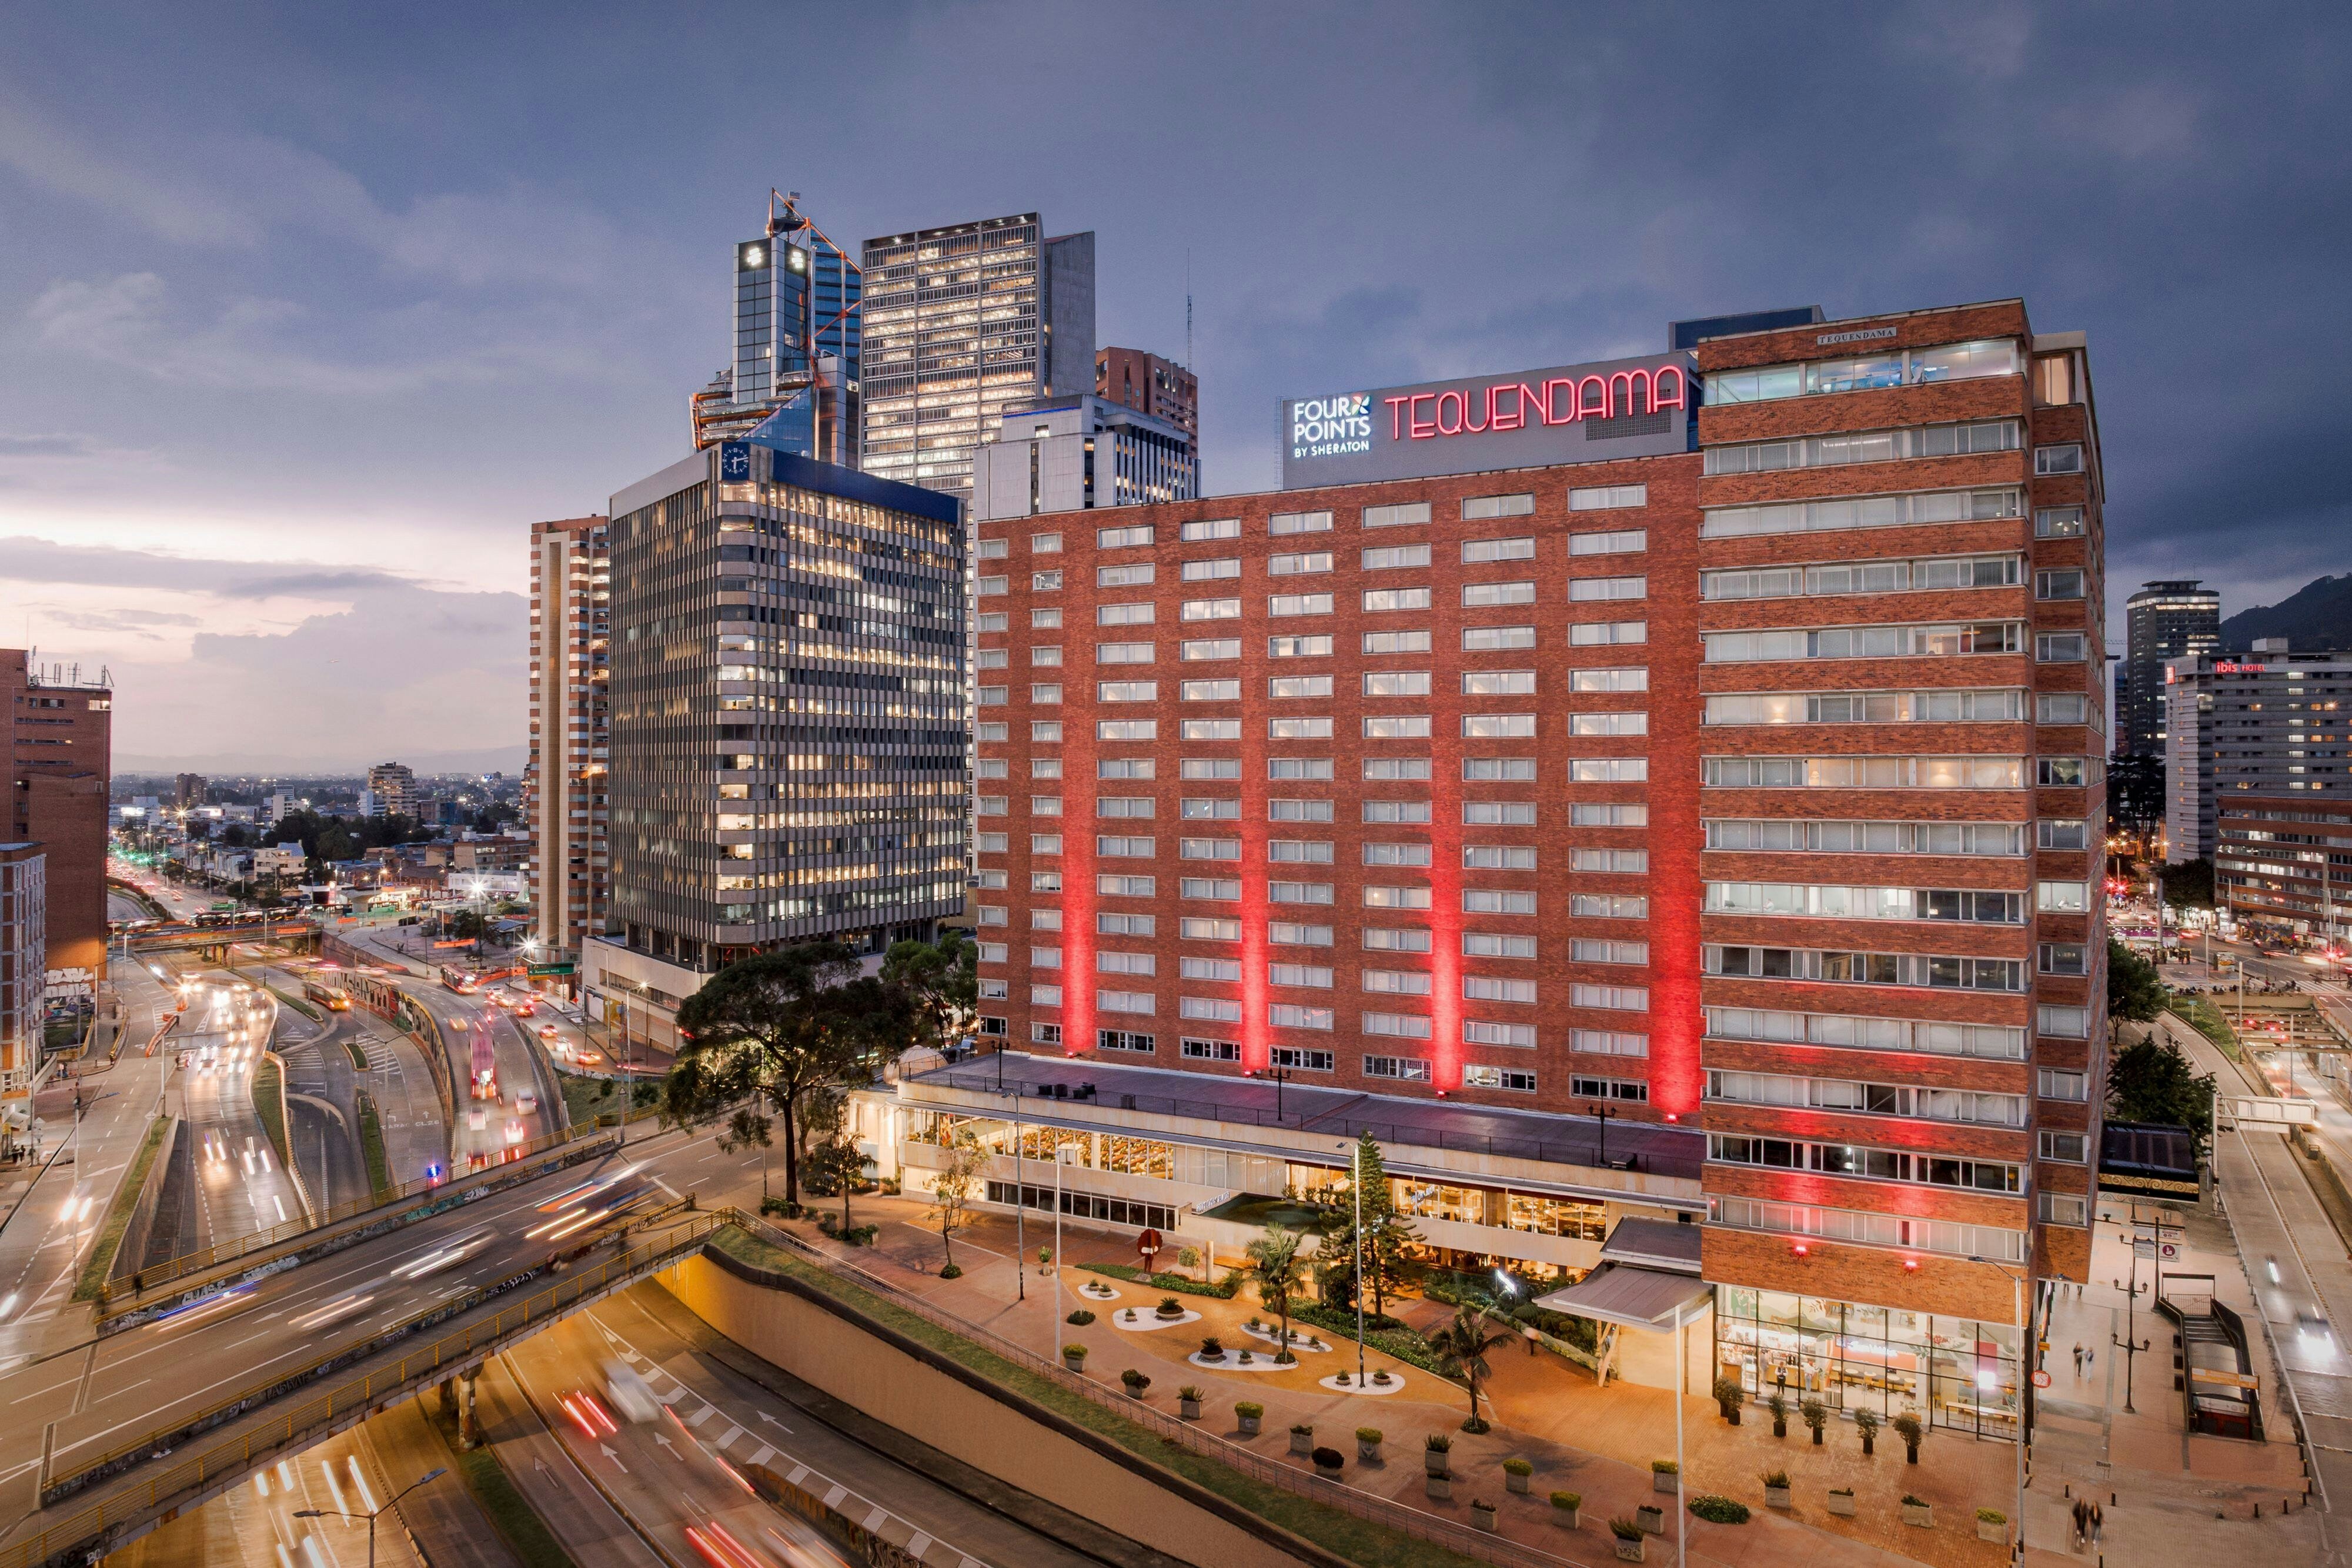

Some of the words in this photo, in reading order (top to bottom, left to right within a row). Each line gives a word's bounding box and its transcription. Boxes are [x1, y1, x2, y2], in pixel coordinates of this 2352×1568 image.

[1820, 329, 1893, 344] TEQUENDAMA
[1294, 397, 1351, 423] FOUR
[1384, 365, 1684, 440] TEQUENDAMA
[1294, 416, 1371, 443] POINTS
[1294, 447, 1308, 458] BY
[1311, 440, 1370, 456] SHERATON
[2216, 661, 2238, 673] ibis
